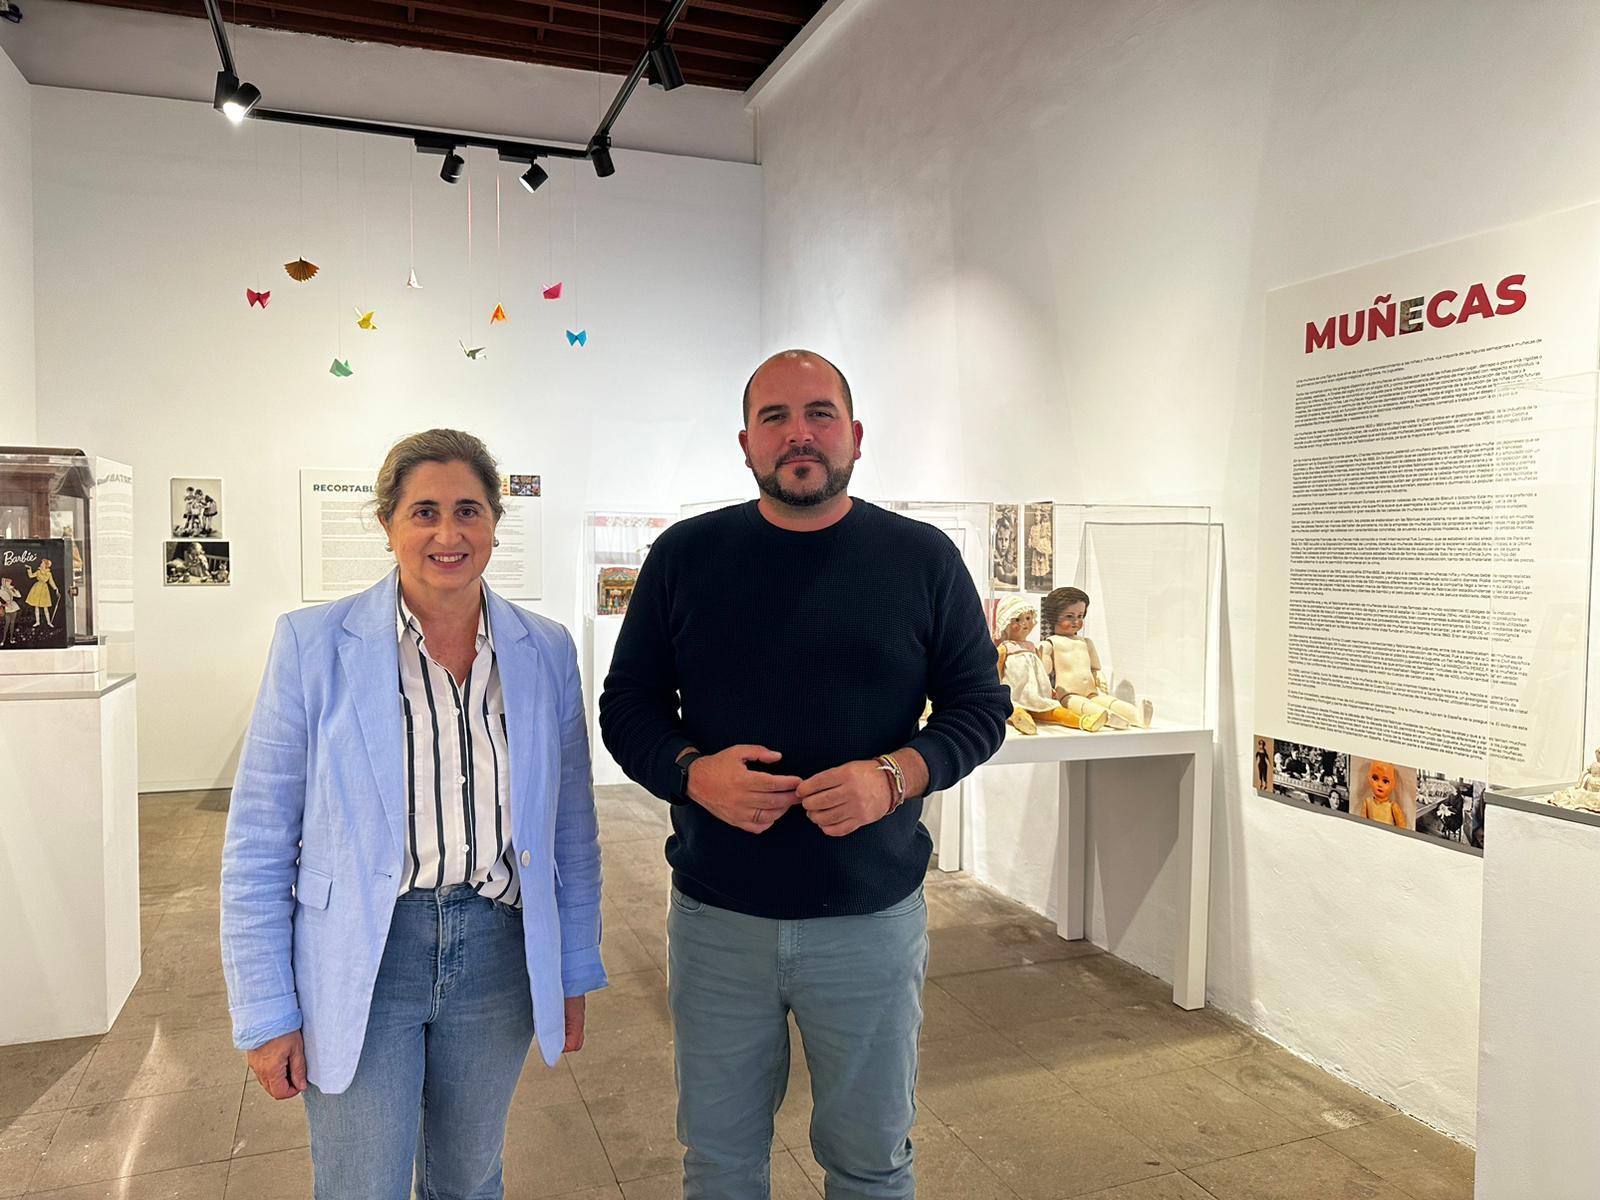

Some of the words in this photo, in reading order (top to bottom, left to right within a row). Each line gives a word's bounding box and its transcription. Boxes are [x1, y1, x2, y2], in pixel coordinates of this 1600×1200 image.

[1304, 274, 1527, 354] MUÑECAS
[313, 484, 376, 493] RECORTABL
[3, 550, 37, 566] Barbie
